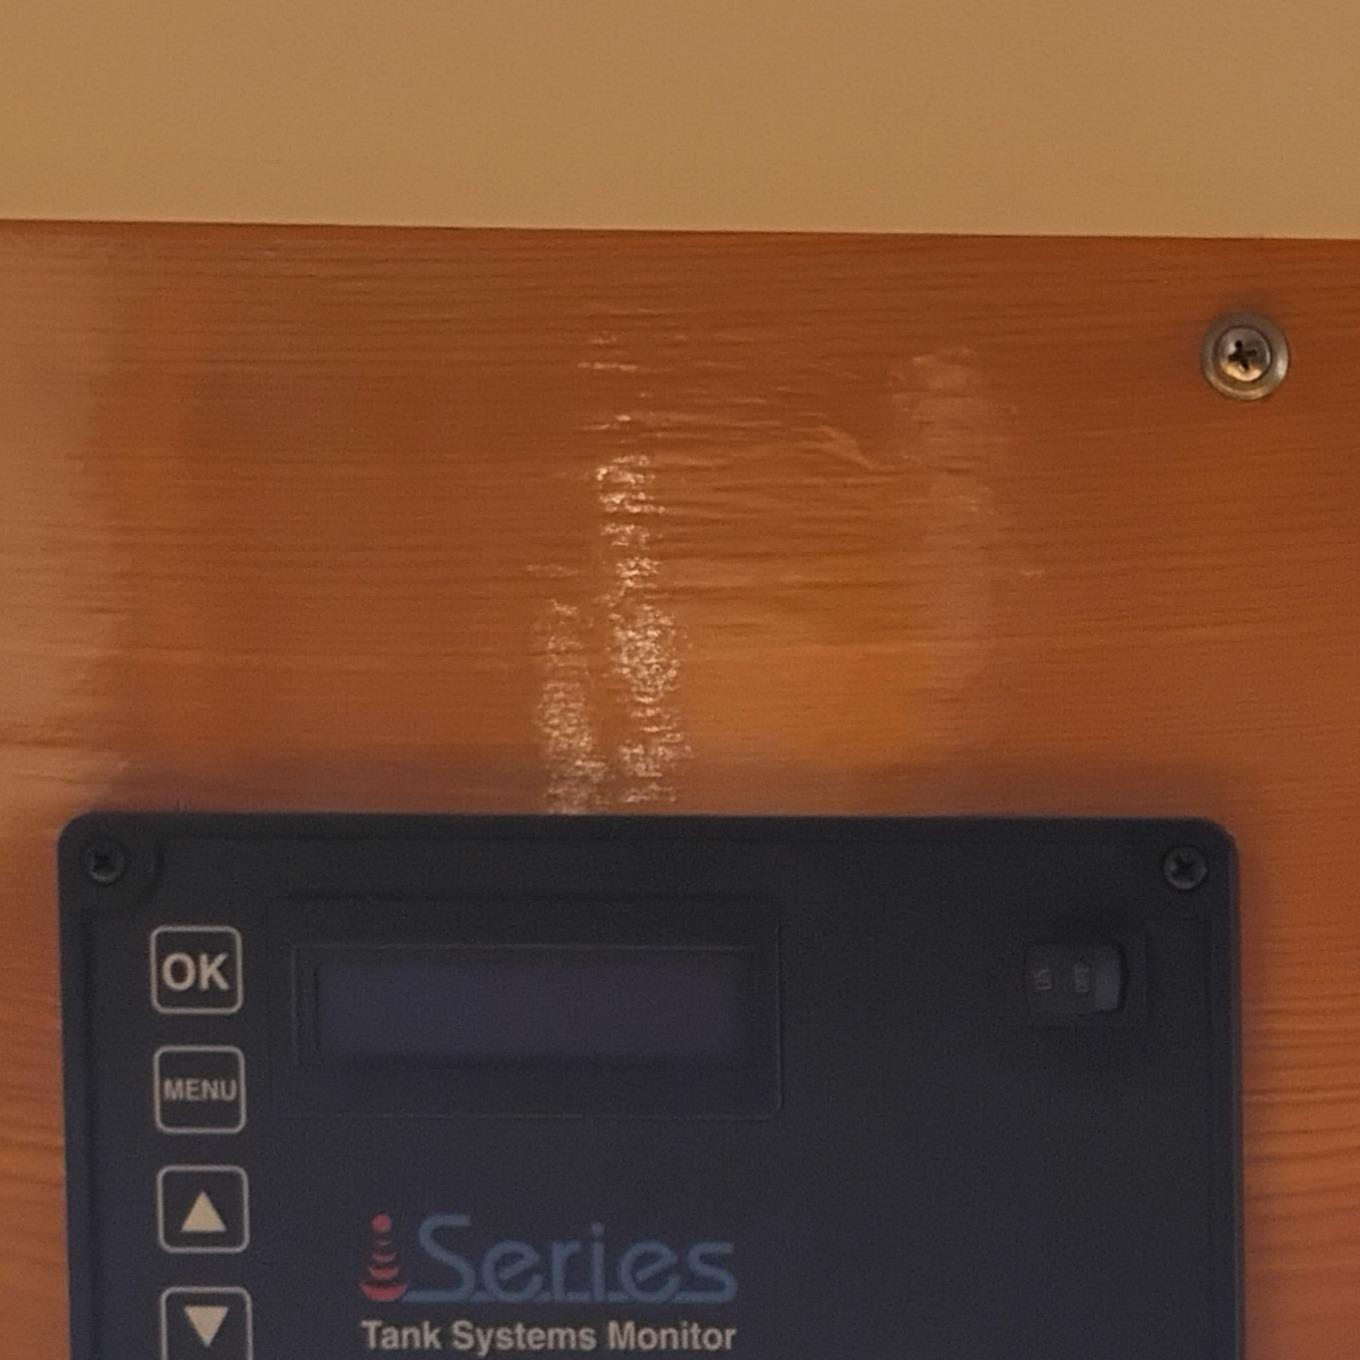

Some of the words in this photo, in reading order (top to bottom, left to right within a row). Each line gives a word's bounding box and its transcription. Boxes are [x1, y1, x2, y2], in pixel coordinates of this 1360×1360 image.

[162, 953, 229, 991] OK
[164, 1079, 237, 1101] MENU
[361, 1320, 441, 1350] Tank
[451, 1320, 596, 1357] Systems
[607, 1321, 736, 1350] Monitor
